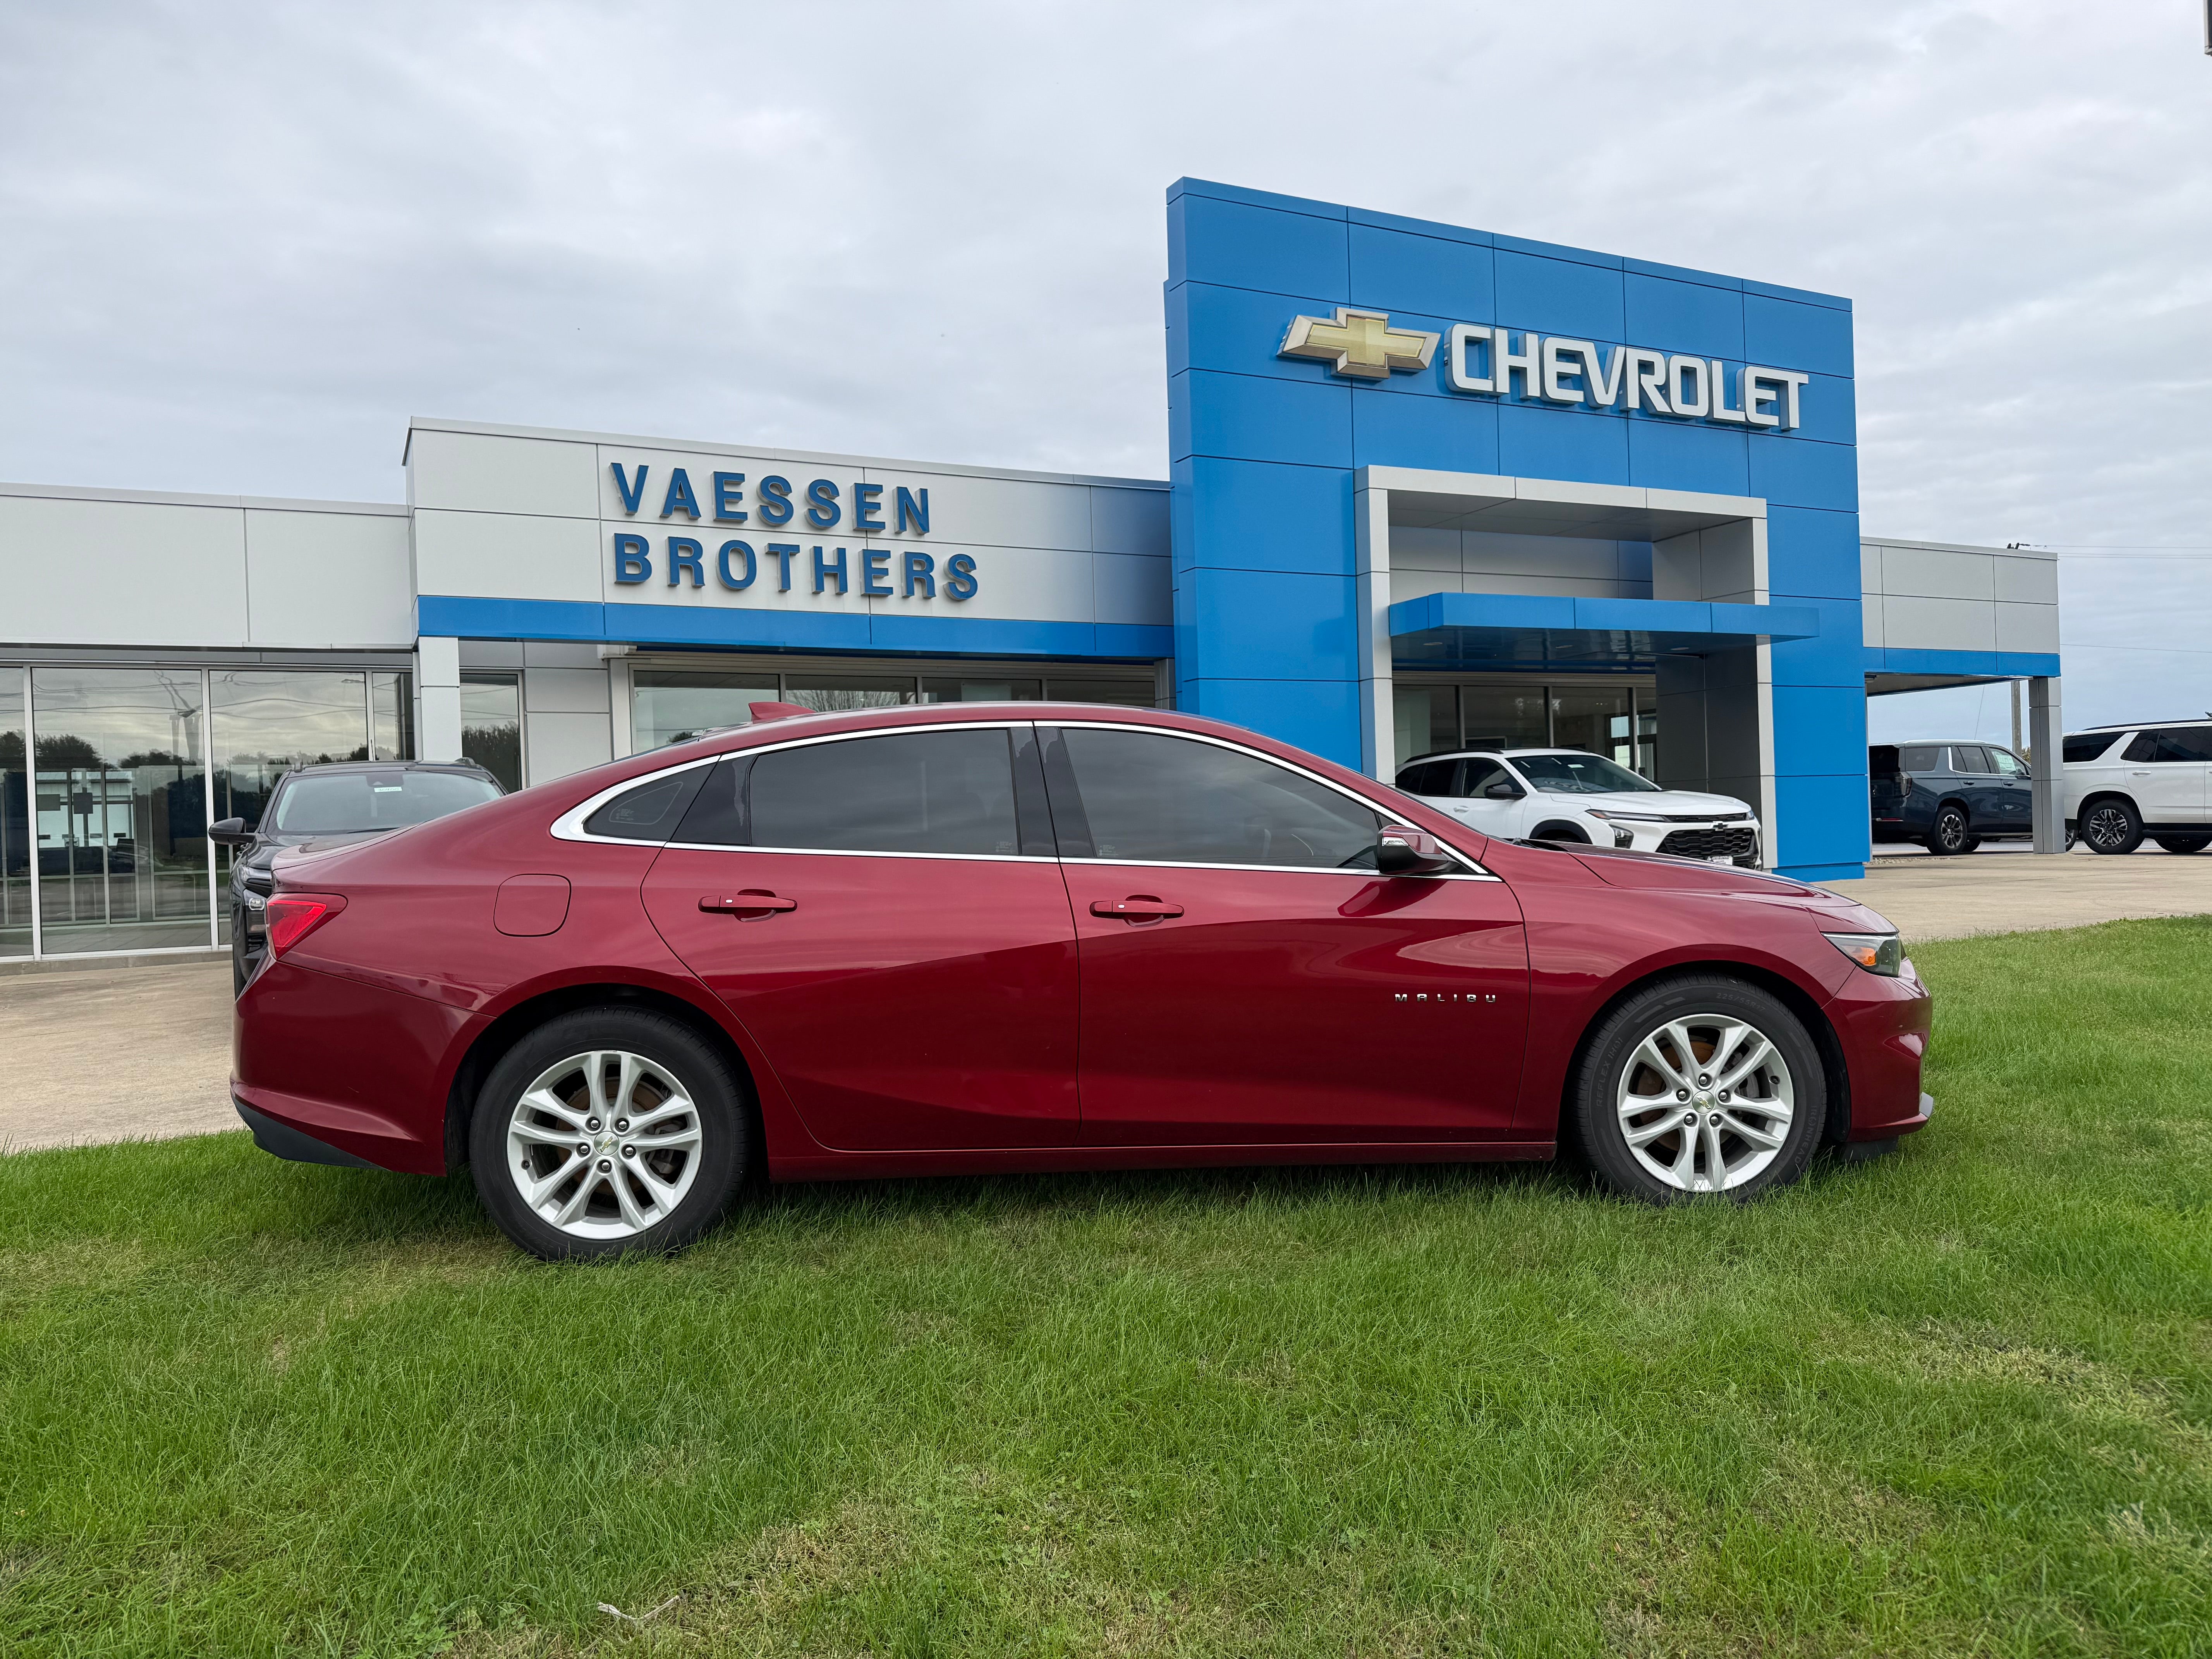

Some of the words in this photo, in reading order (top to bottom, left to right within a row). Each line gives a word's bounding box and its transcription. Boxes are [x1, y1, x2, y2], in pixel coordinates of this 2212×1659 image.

[1447, 323, 1809, 430] CHEVROLET
[610, 462, 930, 535] VAESSEN
[613, 533, 978, 601] BROTHERS
[1395, 994, 1496, 1002] MALIBU
[1716, 992, 1766, 1011] 225/55R17
[1596, 1060, 1611, 1107] REFLEX
[1794, 1106, 1817, 1163] IRONHEAD
